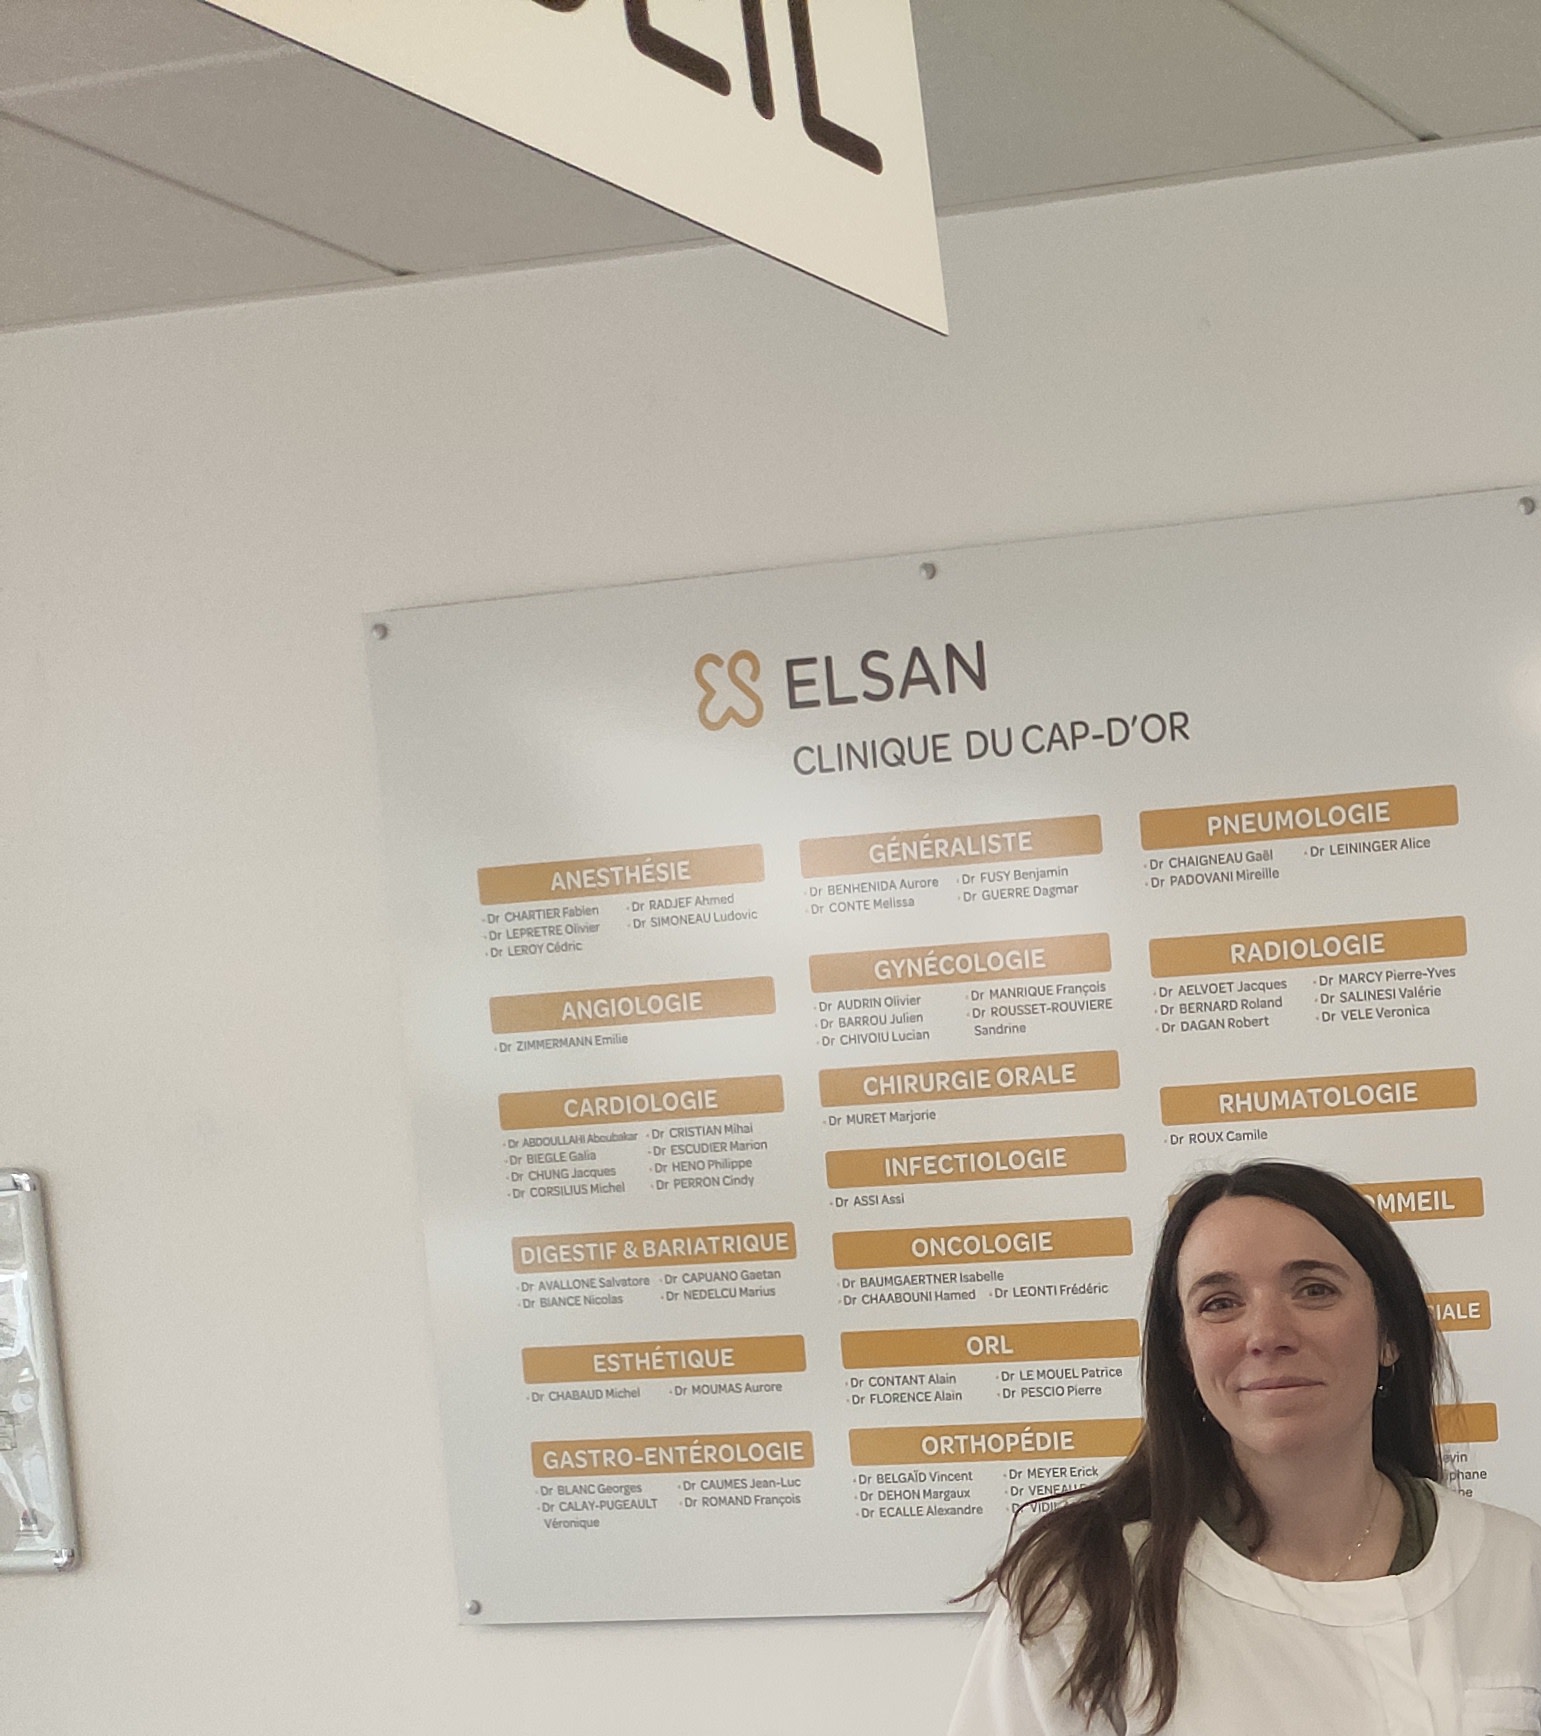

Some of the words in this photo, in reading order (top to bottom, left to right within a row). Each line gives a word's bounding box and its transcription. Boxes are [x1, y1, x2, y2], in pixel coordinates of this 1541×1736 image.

[785, 639, 987, 710] ELSAN
[793, 733, 952, 775] CLINIQUE
[966, 727, 1013, 760] DU
[1022, 712, 1190, 755] CAP-D'OR
[1208, 801, 1391, 836] PNEUMOLOGIE
[869, 831, 1032, 864] GÉNÉRALISTE
[1149, 858, 1163, 870] Dr
[1168, 852, 1242, 869] CHAIGNEAU
[1245, 850, 1273, 863] Gaël
[1309, 846, 1324, 857] Dr
[1329, 840, 1398, 856] LEININGER
[1400, 837, 1431, 850] Alice
[550, 857, 691, 892] ANESTHÉSIE
[1151, 877, 1164, 888] Dr
[1170, 871, 1233, 887] PADOVANI
[1236, 867, 1279, 882] Mireille
[648, 896, 693, 911] RADJEF
[694, 893, 735, 907] Ahmed
[1230, 933, 1385, 964] RADIOLOGIE
[874, 949, 1046, 980] GYNÉCOLOGIE
[1319, 975, 1333, 987] Dr
[1338, 971, 1382, 985] MARCY
[1385, 966, 1456, 982] Pierre-Yves
[561, 992, 703, 1021] ANGIOLOGIE
[1321, 1011, 1335, 1022] Dr
[1341, 1008, 1373, 1021] VELE
[1376, 1005, 1430, 1019] Veronica
[863, 1069, 990, 1097] CHIRURGIE
[996, 1063, 1076, 1088] ORALE
[563, 1090, 718, 1118] CARDIOLOGIE
[1218, 1082, 1418, 1114] RHUMATOLOGIE
[1169, 1133, 1184, 1145] Dr
[1188, 1131, 1223, 1144] ROUX
[1226, 1129, 1268, 1142] Camile
[884, 1148, 1067, 1177] INFECTIOLOGIE
[835, 1196, 849, 1207] Dr
[853, 1195, 879, 1207] ASSI
[881, 1193, 905, 1205] Assi
[1365, 1191, 1455, 1214] MMEIL
[520, 1240, 617, 1265] DIGESTIF
[623, 1239, 639, 1259] &
[642, 1232, 789, 1258] BARIATRIQUE
[911, 1231, 1053, 1258] ONCOLOGIE
[1012, 1285, 1057, 1298] LEONTI
[1060, 1282, 1109, 1296] Frédéric
[1436, 1303, 1481, 1321] IALE
[966, 1335, 1014, 1356] ORL
[592, 1346, 735, 1373] ESTHÉTIQUE
[921, 1426, 1075, 1456] ORTHOPÉDIE
[543, 1440, 804, 1470] GASTRO-ENTÉROLOGIE
[876, 1471, 927, 1484] BELGAÏD
[929, 1470, 973, 1483] Vincent
[877, 1489, 920, 1501] DEHON
[922, 1487, 971, 1501] Margaux
[879, 1505, 923, 1518] ECALLE
[926, 1503, 983, 1516] Alexandre
